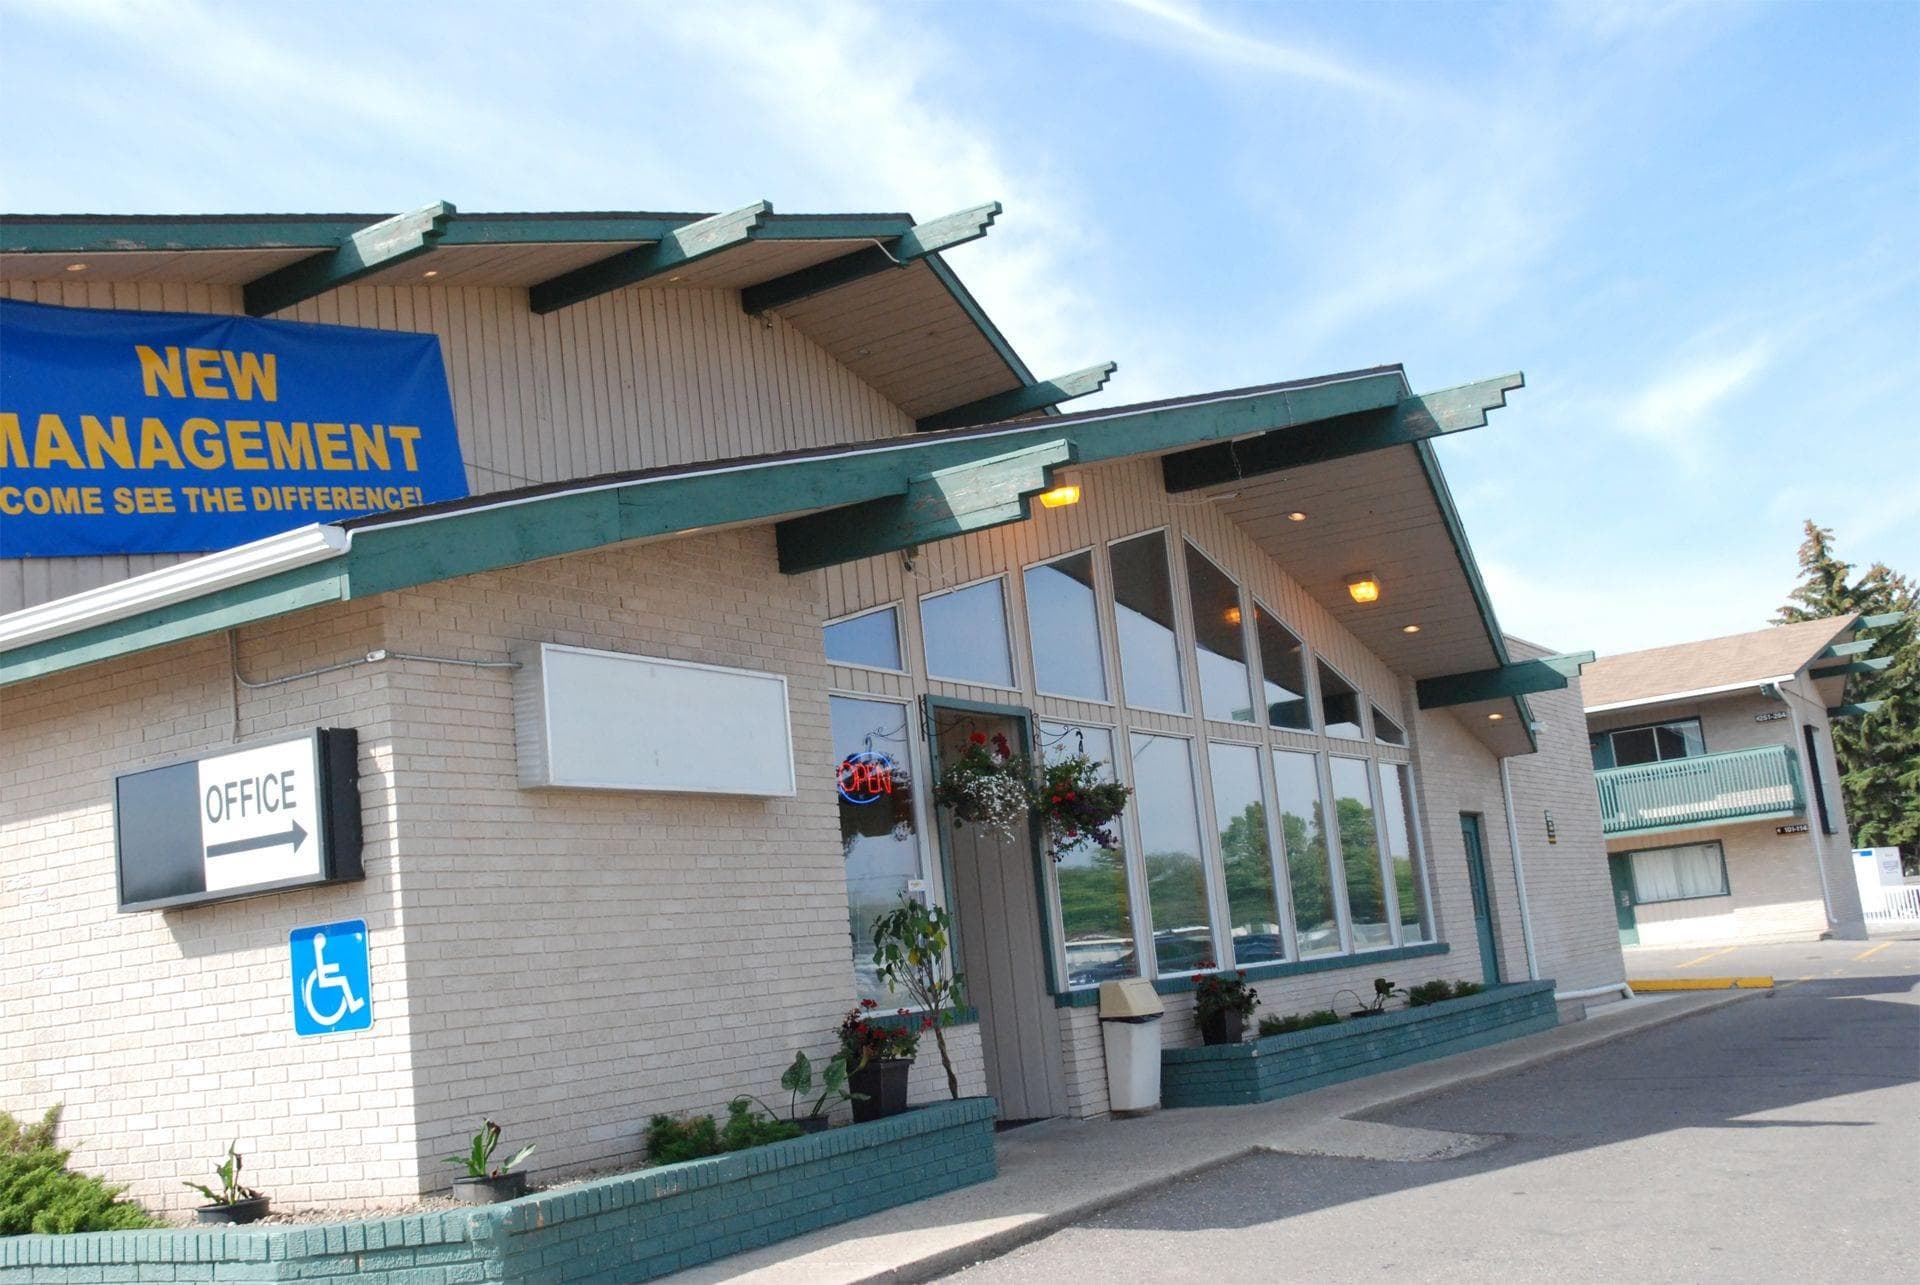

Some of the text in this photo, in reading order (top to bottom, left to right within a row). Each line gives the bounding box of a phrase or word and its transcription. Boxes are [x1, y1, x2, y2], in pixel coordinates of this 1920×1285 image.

[135, 345, 277, 402] NEW
[0, 412, 421, 471] MANAGEMENT
[0, 486, 424, 515] COME SEE THE DIFFERENCE!
[206, 770, 296, 823] OFFICE
[839, 761, 892, 794] OPEN
